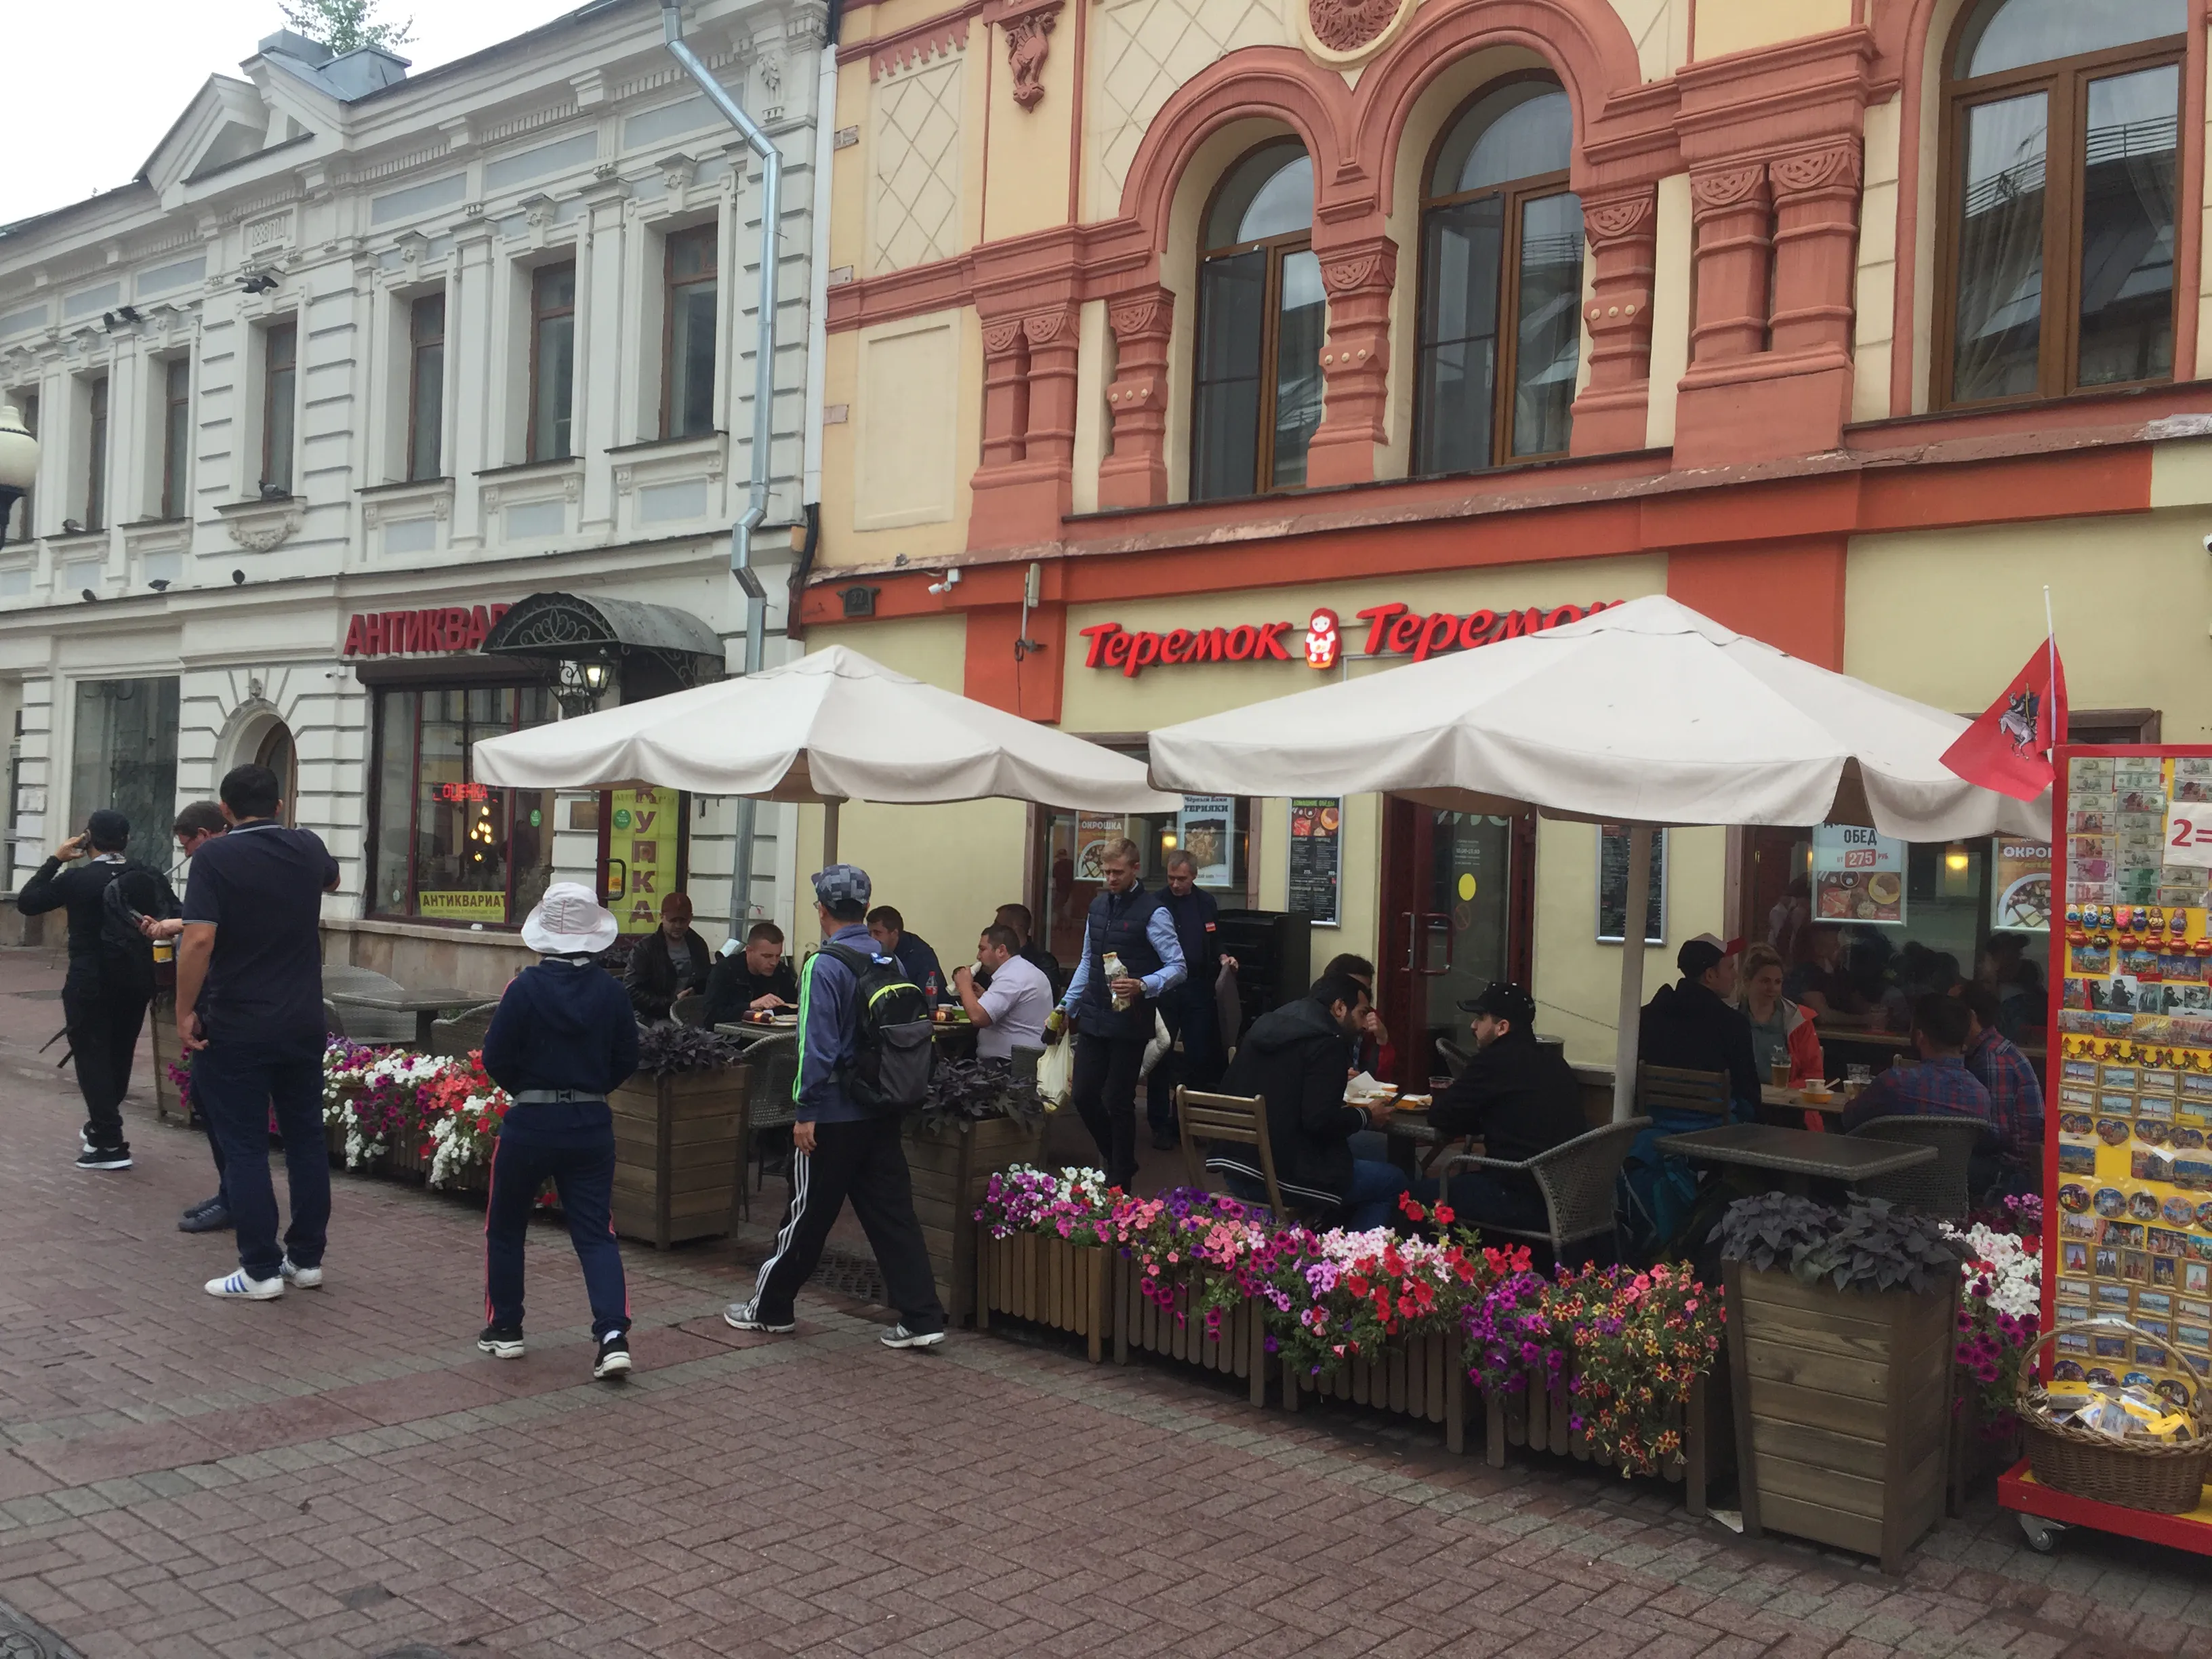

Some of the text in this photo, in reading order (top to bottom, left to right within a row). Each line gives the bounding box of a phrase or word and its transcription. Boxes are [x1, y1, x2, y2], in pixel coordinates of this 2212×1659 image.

[1356, 599, 1626, 663] Теремо
[1079, 622, 1294, 678] Теремок
[1082, 821, 1122, 830] ОКРОШКА
[1844, 829, 1877, 846] ОБЕД
[1849, 851, 1874, 865] 275
[423, 895, 506, 907] АНТИКВАРИАТ
